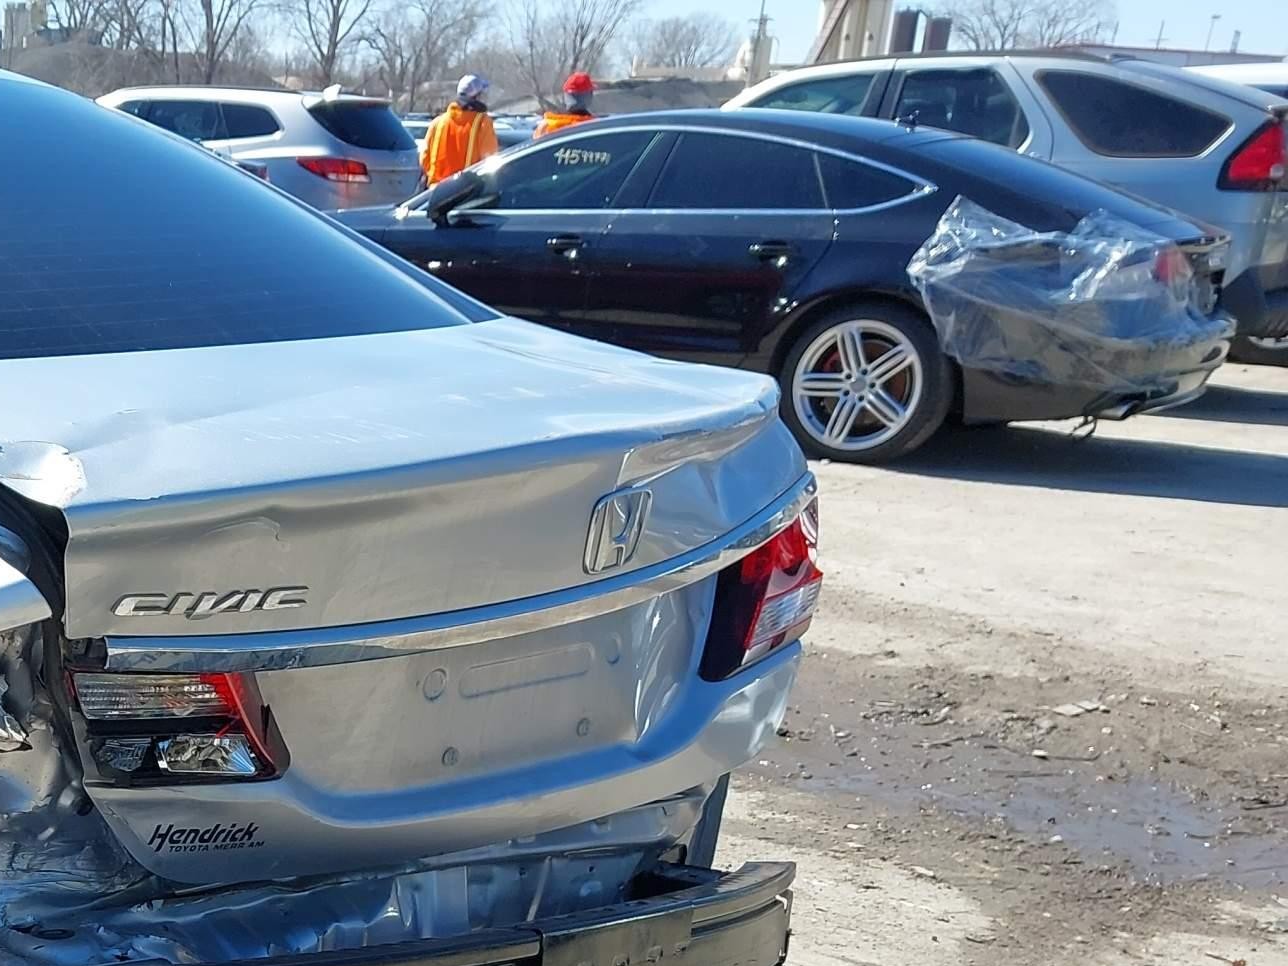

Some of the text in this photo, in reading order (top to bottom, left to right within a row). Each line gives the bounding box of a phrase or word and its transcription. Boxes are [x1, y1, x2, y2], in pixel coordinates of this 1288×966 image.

[112, 585, 309, 620] CIVIC
[147, 822, 260, 852] Hendrick
[169, 845, 209, 853] TOYOTA
